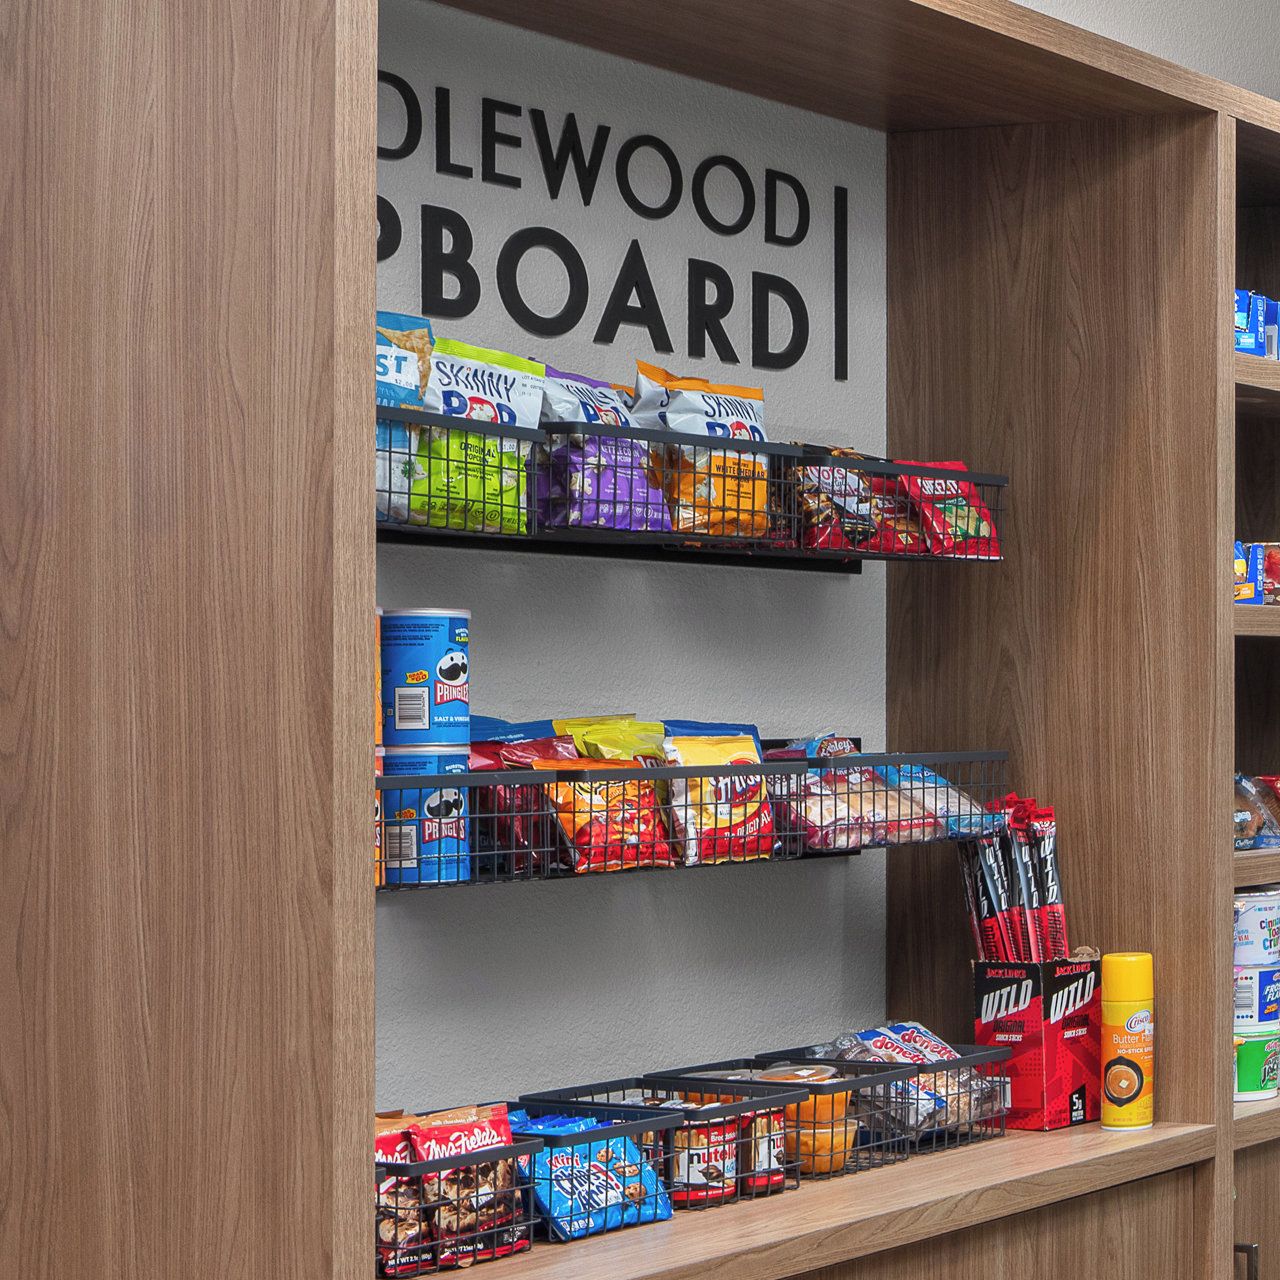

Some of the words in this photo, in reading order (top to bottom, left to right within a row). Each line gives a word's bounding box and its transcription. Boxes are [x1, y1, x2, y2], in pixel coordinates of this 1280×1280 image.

[981, 979, 1032, 1025] WILD
[1050, 971, 1096, 1025] WILD
[992, 1020, 1026, 1034] ORIGINAL
[1061, 1014, 1090, 1030] ORIGINAL
[1113, 1034, 1138, 1044] Butter
[1117, 1047, 1143, 1055] NO-STICK
